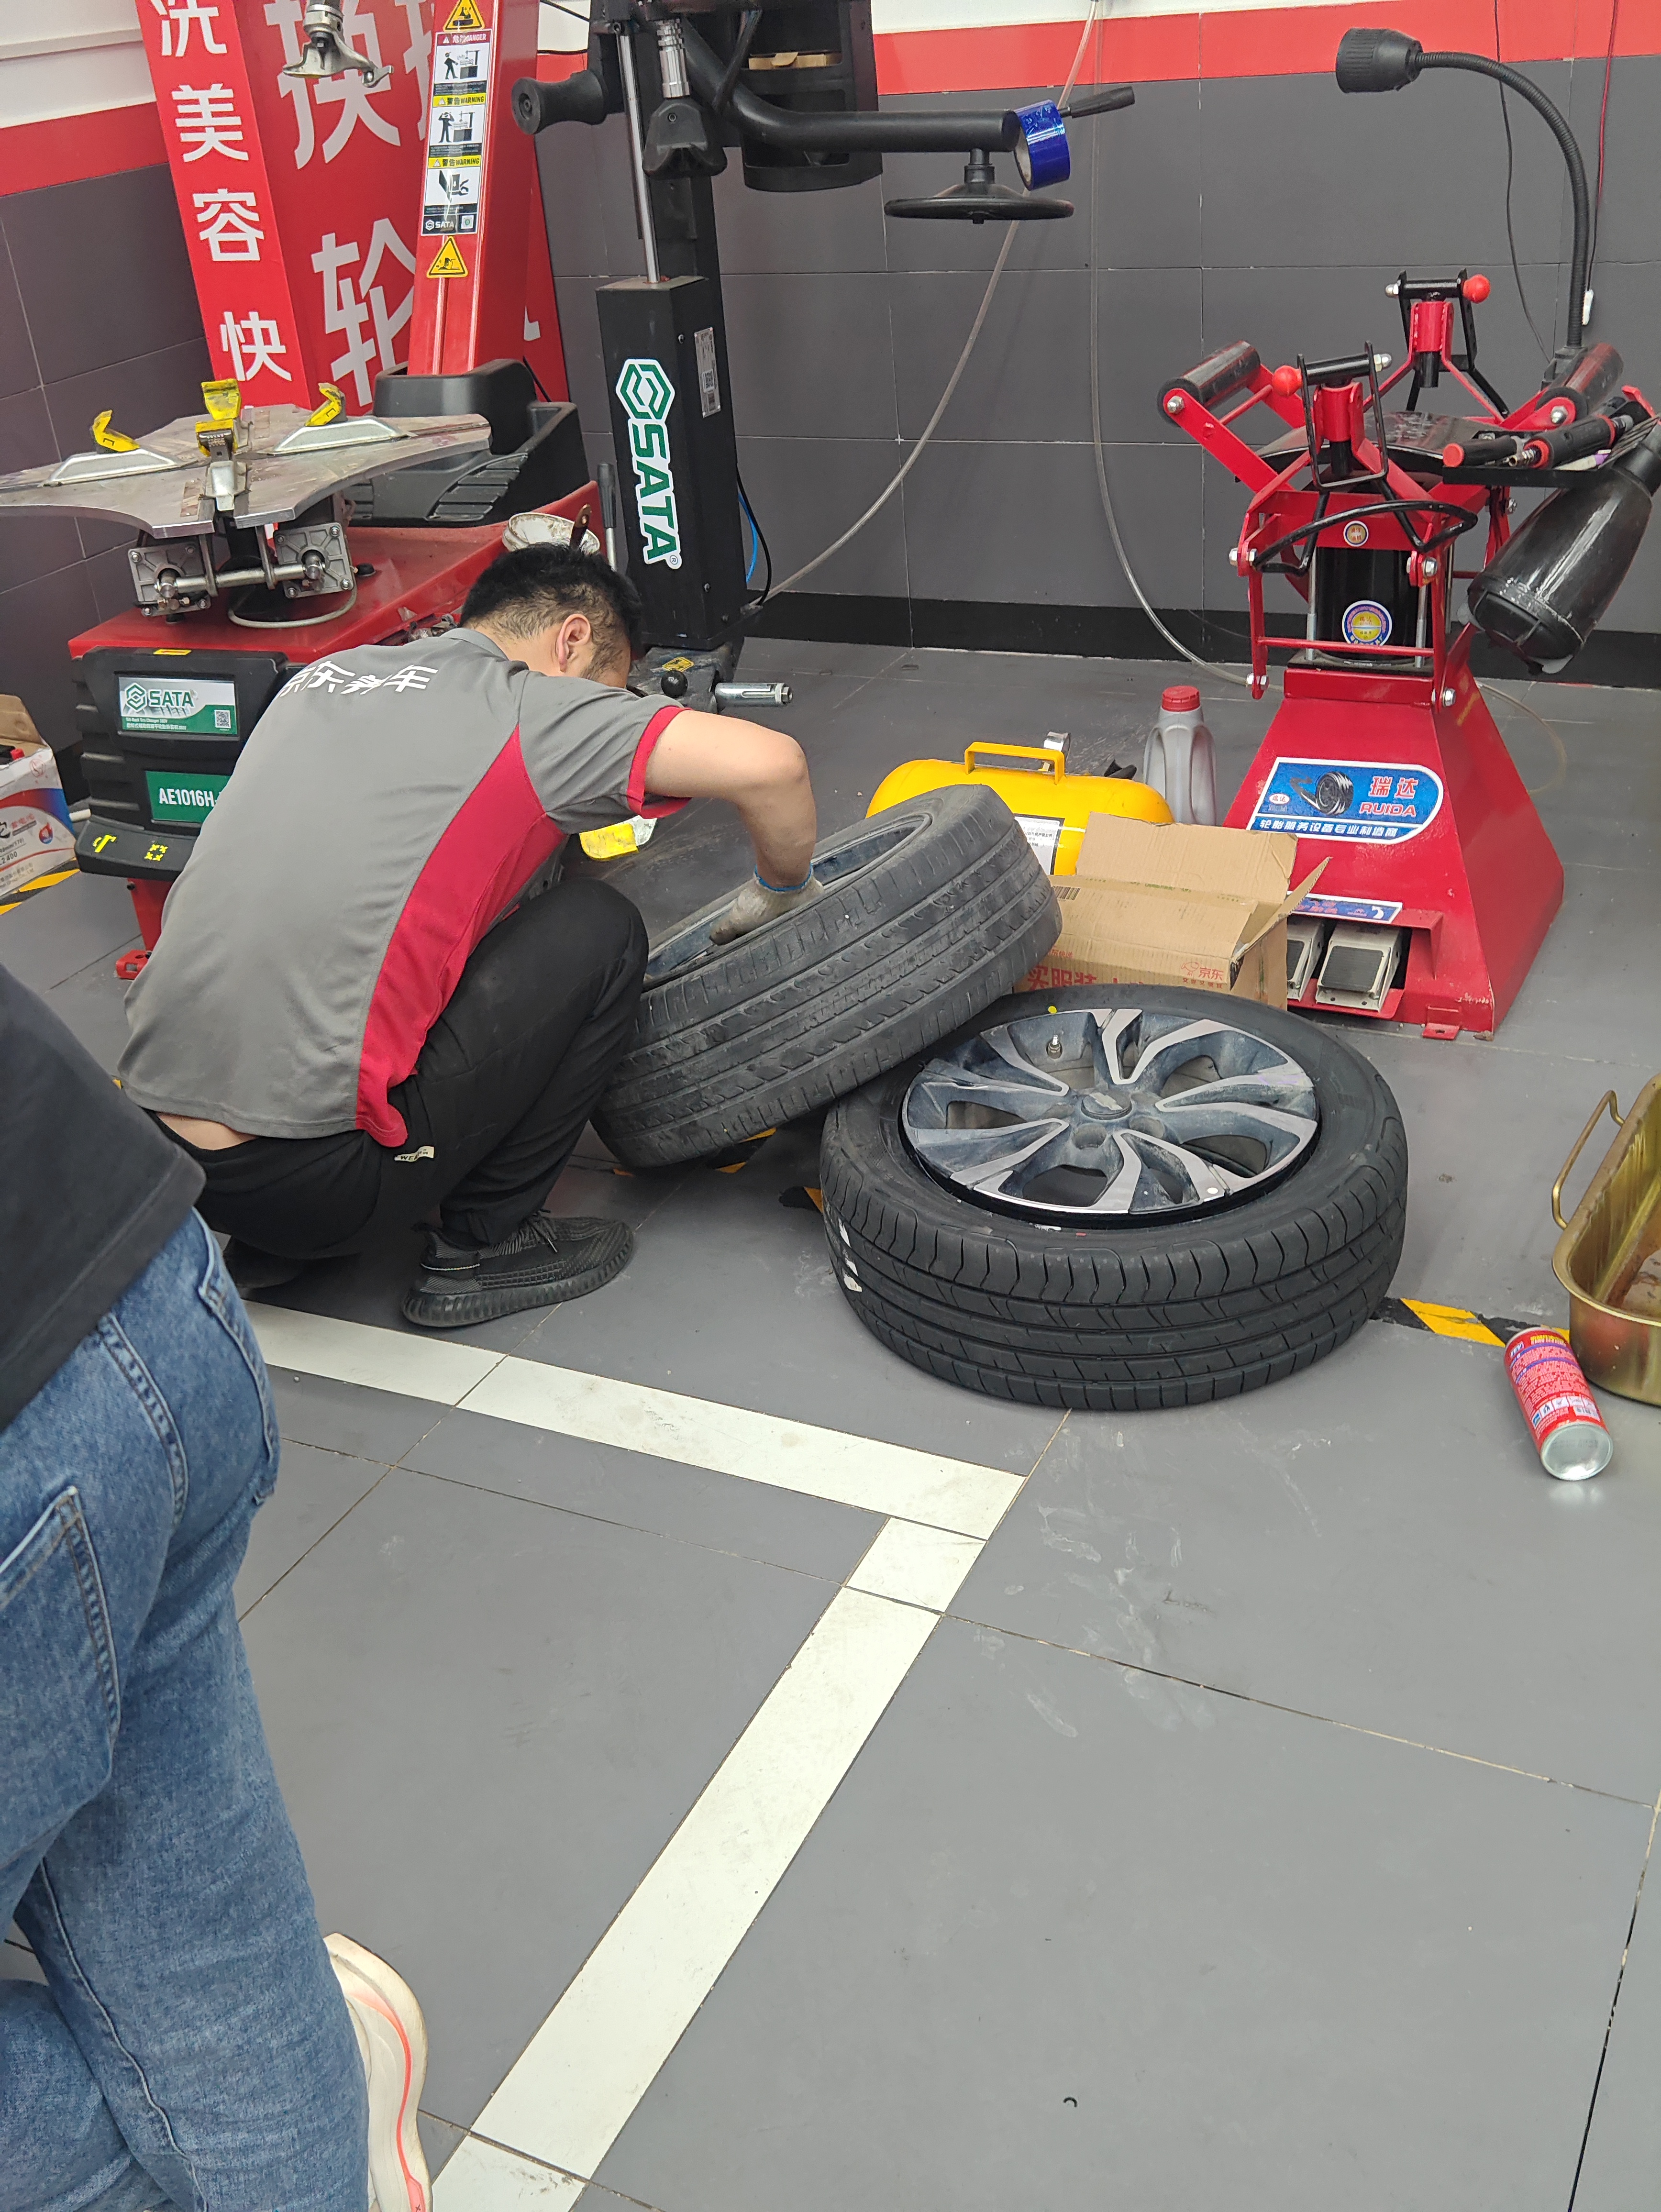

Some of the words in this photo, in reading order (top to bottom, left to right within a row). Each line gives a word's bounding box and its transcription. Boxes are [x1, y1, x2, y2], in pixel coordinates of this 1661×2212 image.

[631, 422, 677, 561] SATA
[149, 690, 194, 707] SATA
[1368, 775, 1419, 799] 瑞达
[159, 788, 221, 807] AE1016H
[1359, 801, 1417, 818] RUIDA
[1198, 967, 1224, 981] 京东
